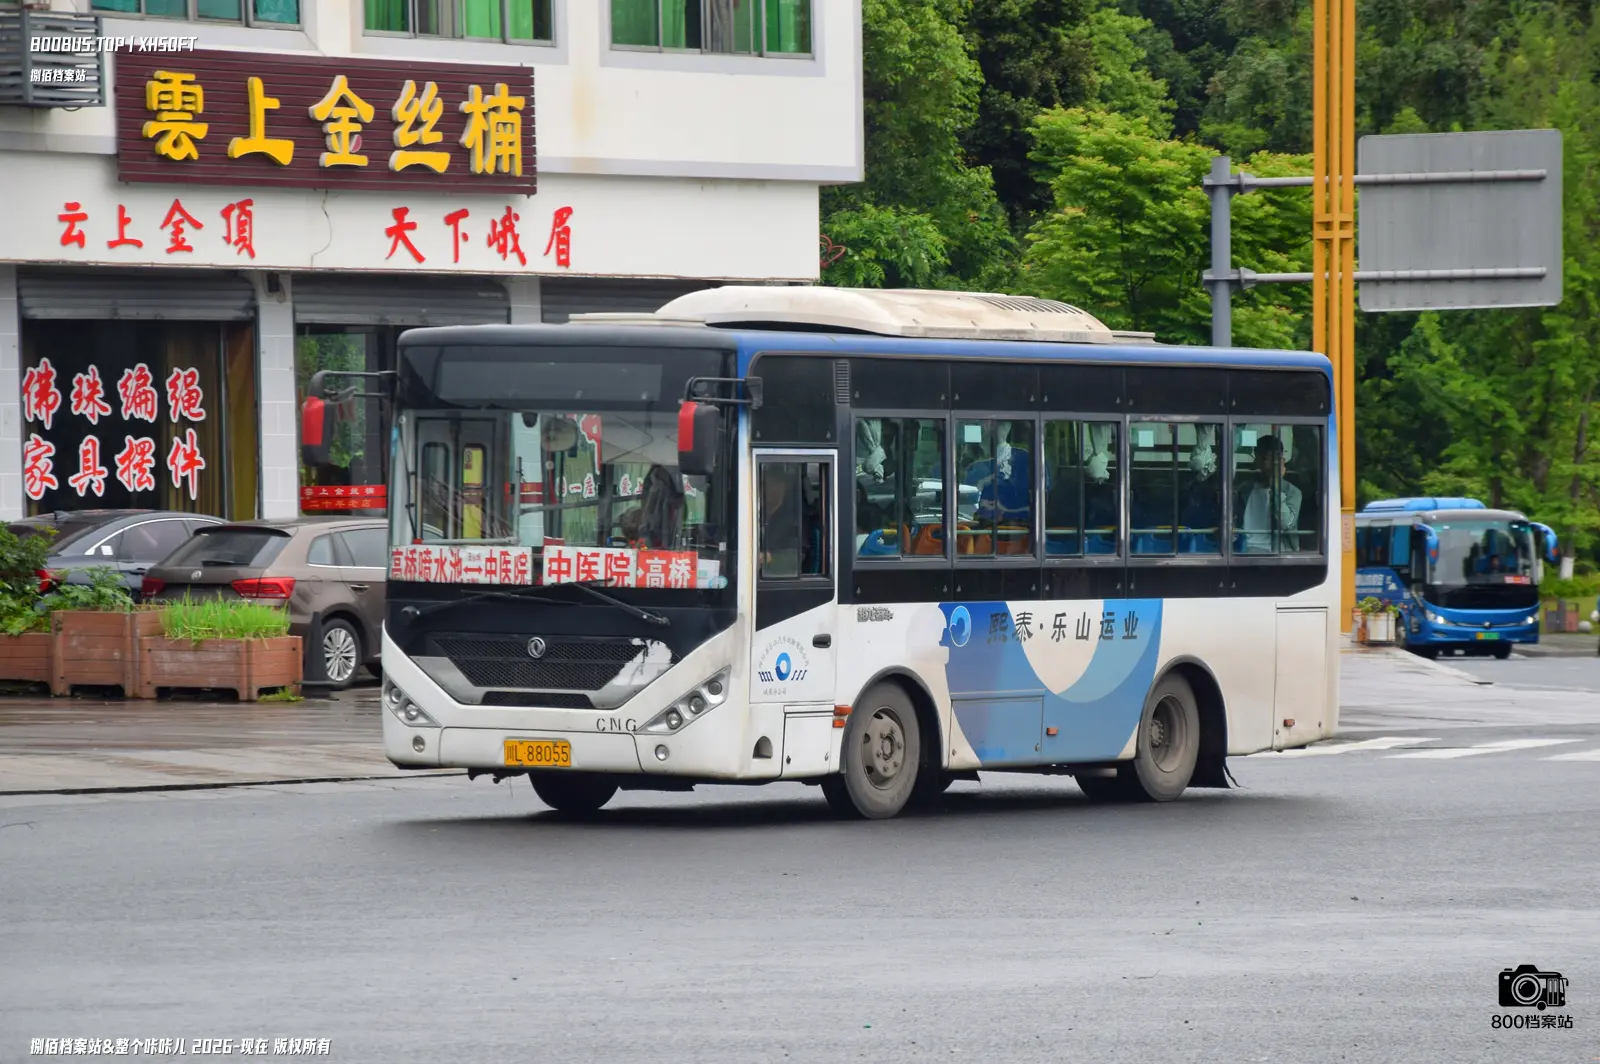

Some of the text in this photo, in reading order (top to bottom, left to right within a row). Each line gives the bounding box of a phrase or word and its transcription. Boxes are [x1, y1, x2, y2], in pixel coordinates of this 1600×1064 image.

[142, 70, 526, 177] 雲上金丝楠
[385, 205, 574, 269] 天下峨眉
[308, 499, 372, 508] 二十年老店
[484, 548, 528, 584] 中医院
[547, 550, 692, 588] 中医院 高桥
[596, 718, 637, 732] CNG
